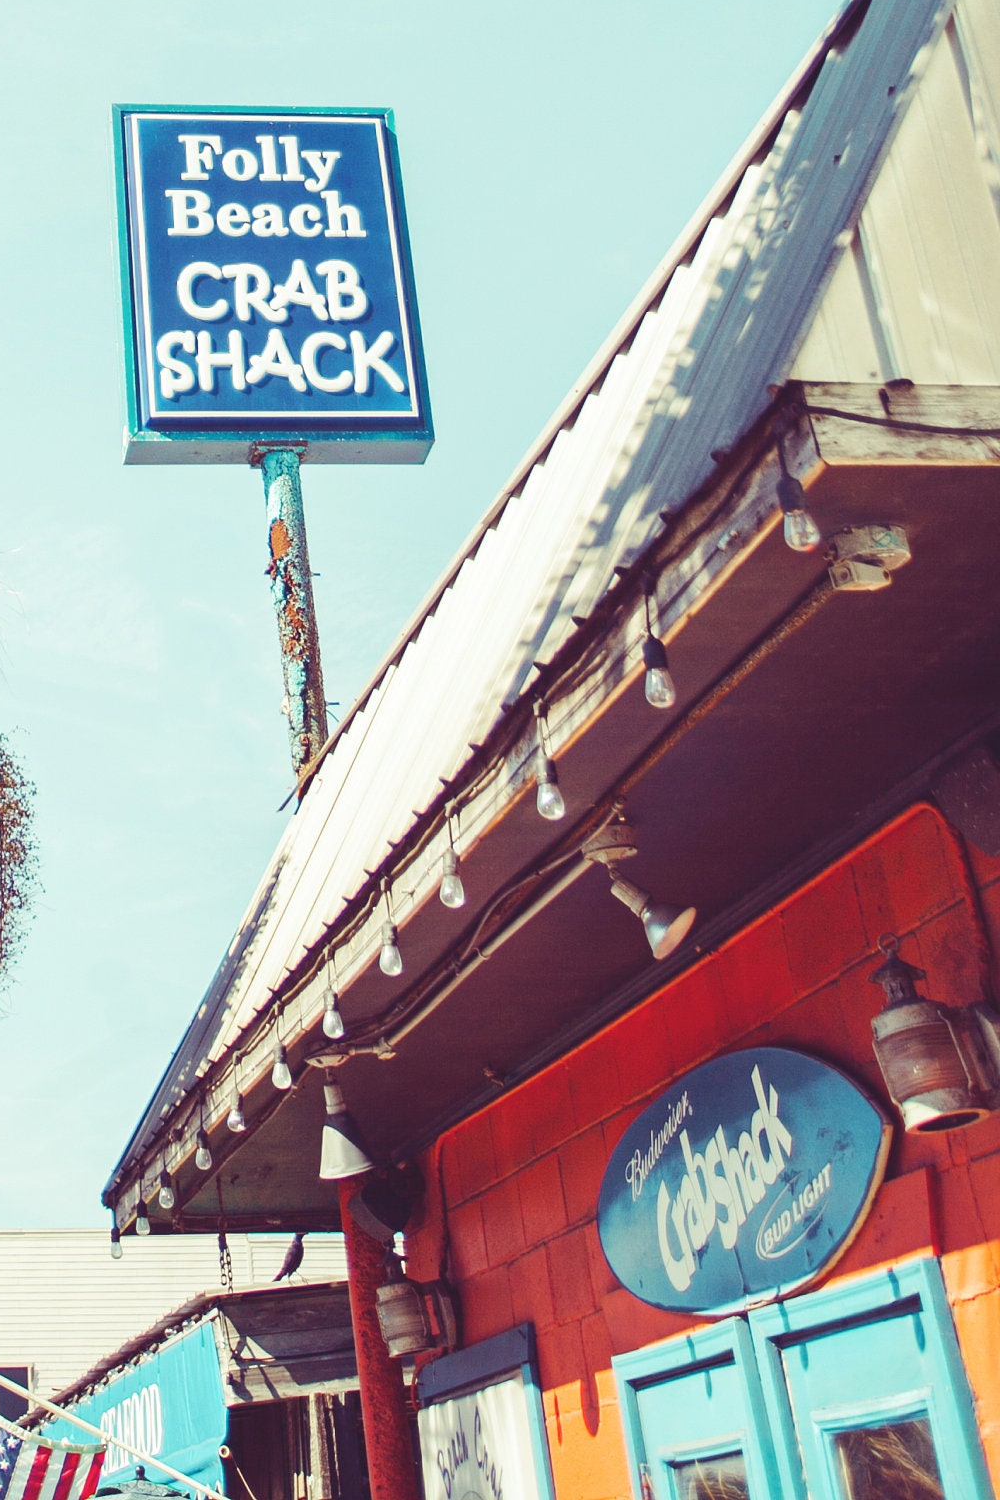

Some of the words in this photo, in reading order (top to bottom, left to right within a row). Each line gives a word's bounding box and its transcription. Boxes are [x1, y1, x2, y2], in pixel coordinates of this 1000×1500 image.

[178, 135, 341, 192] Folly
[165, 189, 367, 237] Beach
[176, 259, 368, 323] CRAB
[156, 329, 405, 399] SHACK
[763, 1209, 792, 1253] BUD
[792, 1162, 832, 1223] LIGHT
[100, 1383, 163, 1477] SEAFOOD
